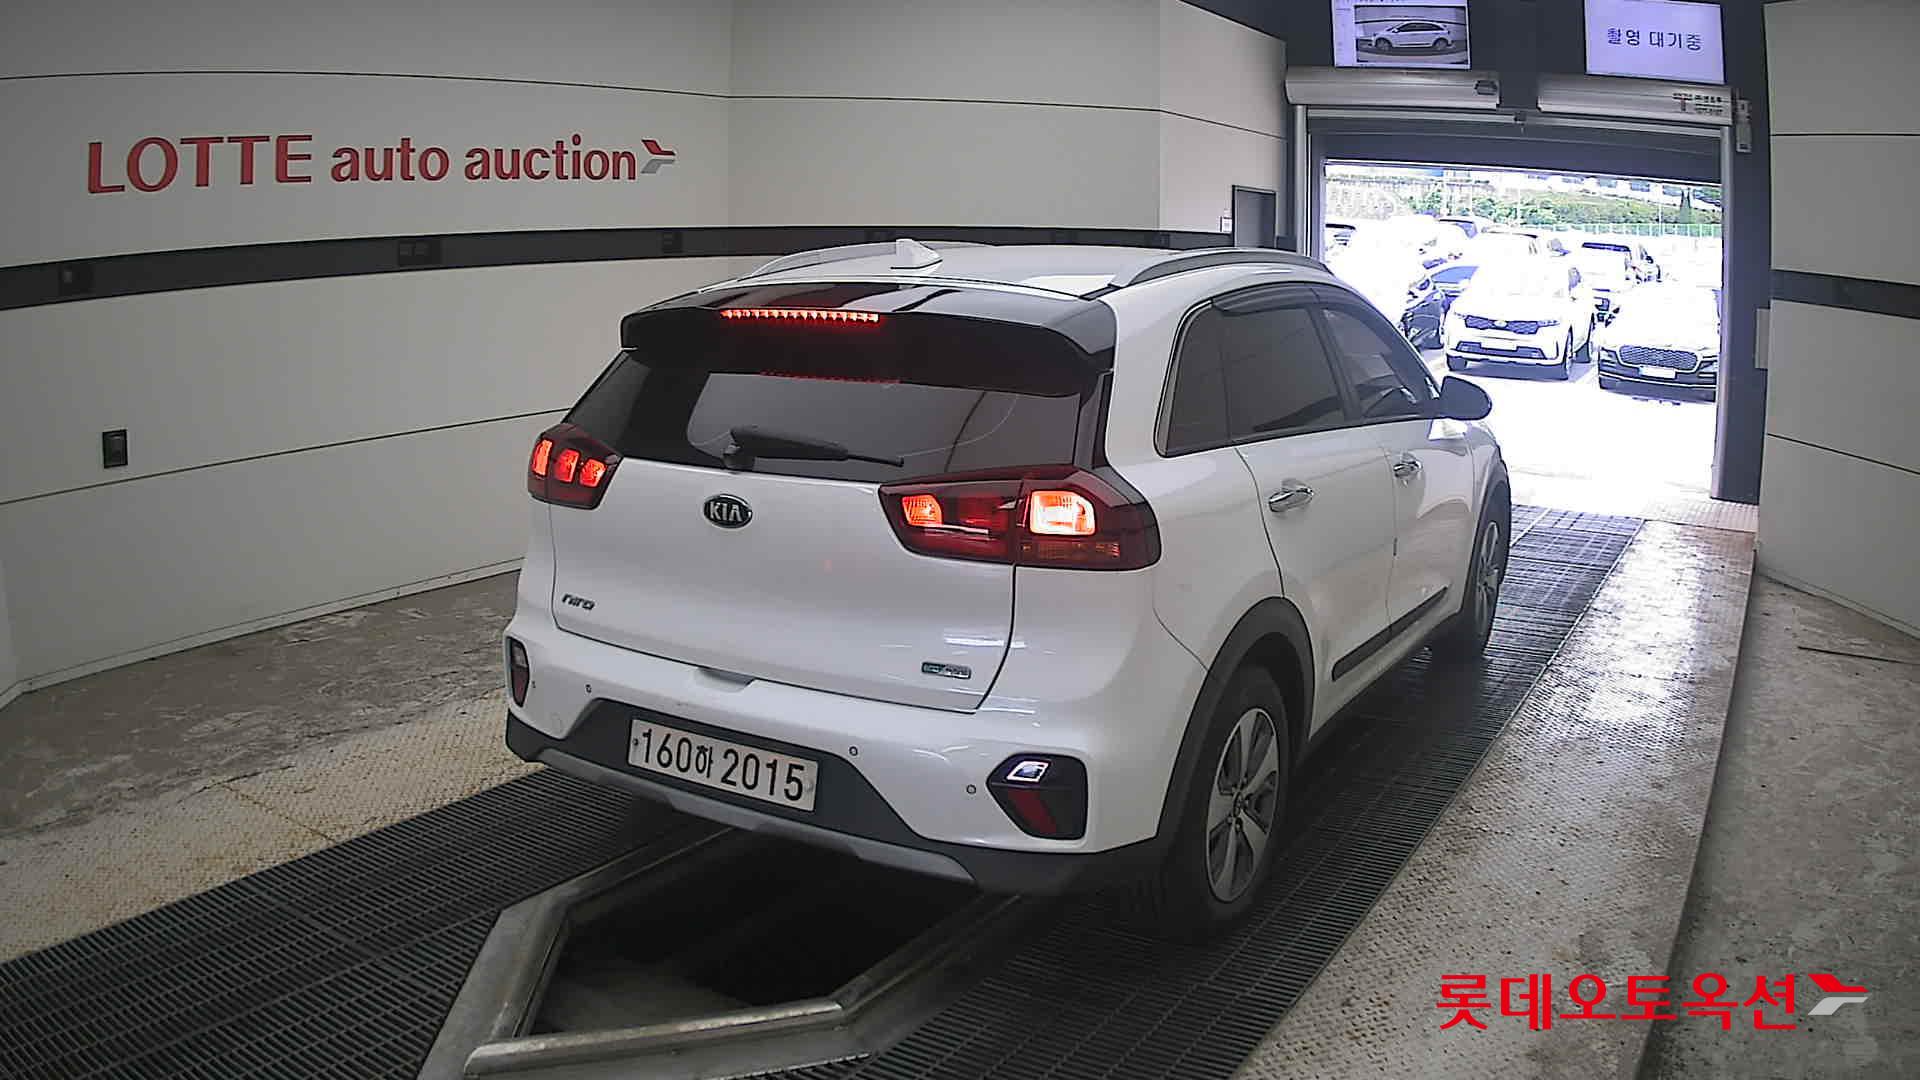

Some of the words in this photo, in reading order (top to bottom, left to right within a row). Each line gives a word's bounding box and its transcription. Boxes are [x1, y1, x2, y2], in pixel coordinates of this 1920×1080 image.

[1649, 31, 1701, 51] 대기중
[88, 134, 313, 194] LOTTE
[331, 137, 451, 182] auto
[464, 134, 638, 181] auction
[710, 501, 742, 522] KIA
[642, 728, 714, 779] 160하
[720, 748, 804, 801] 2015
